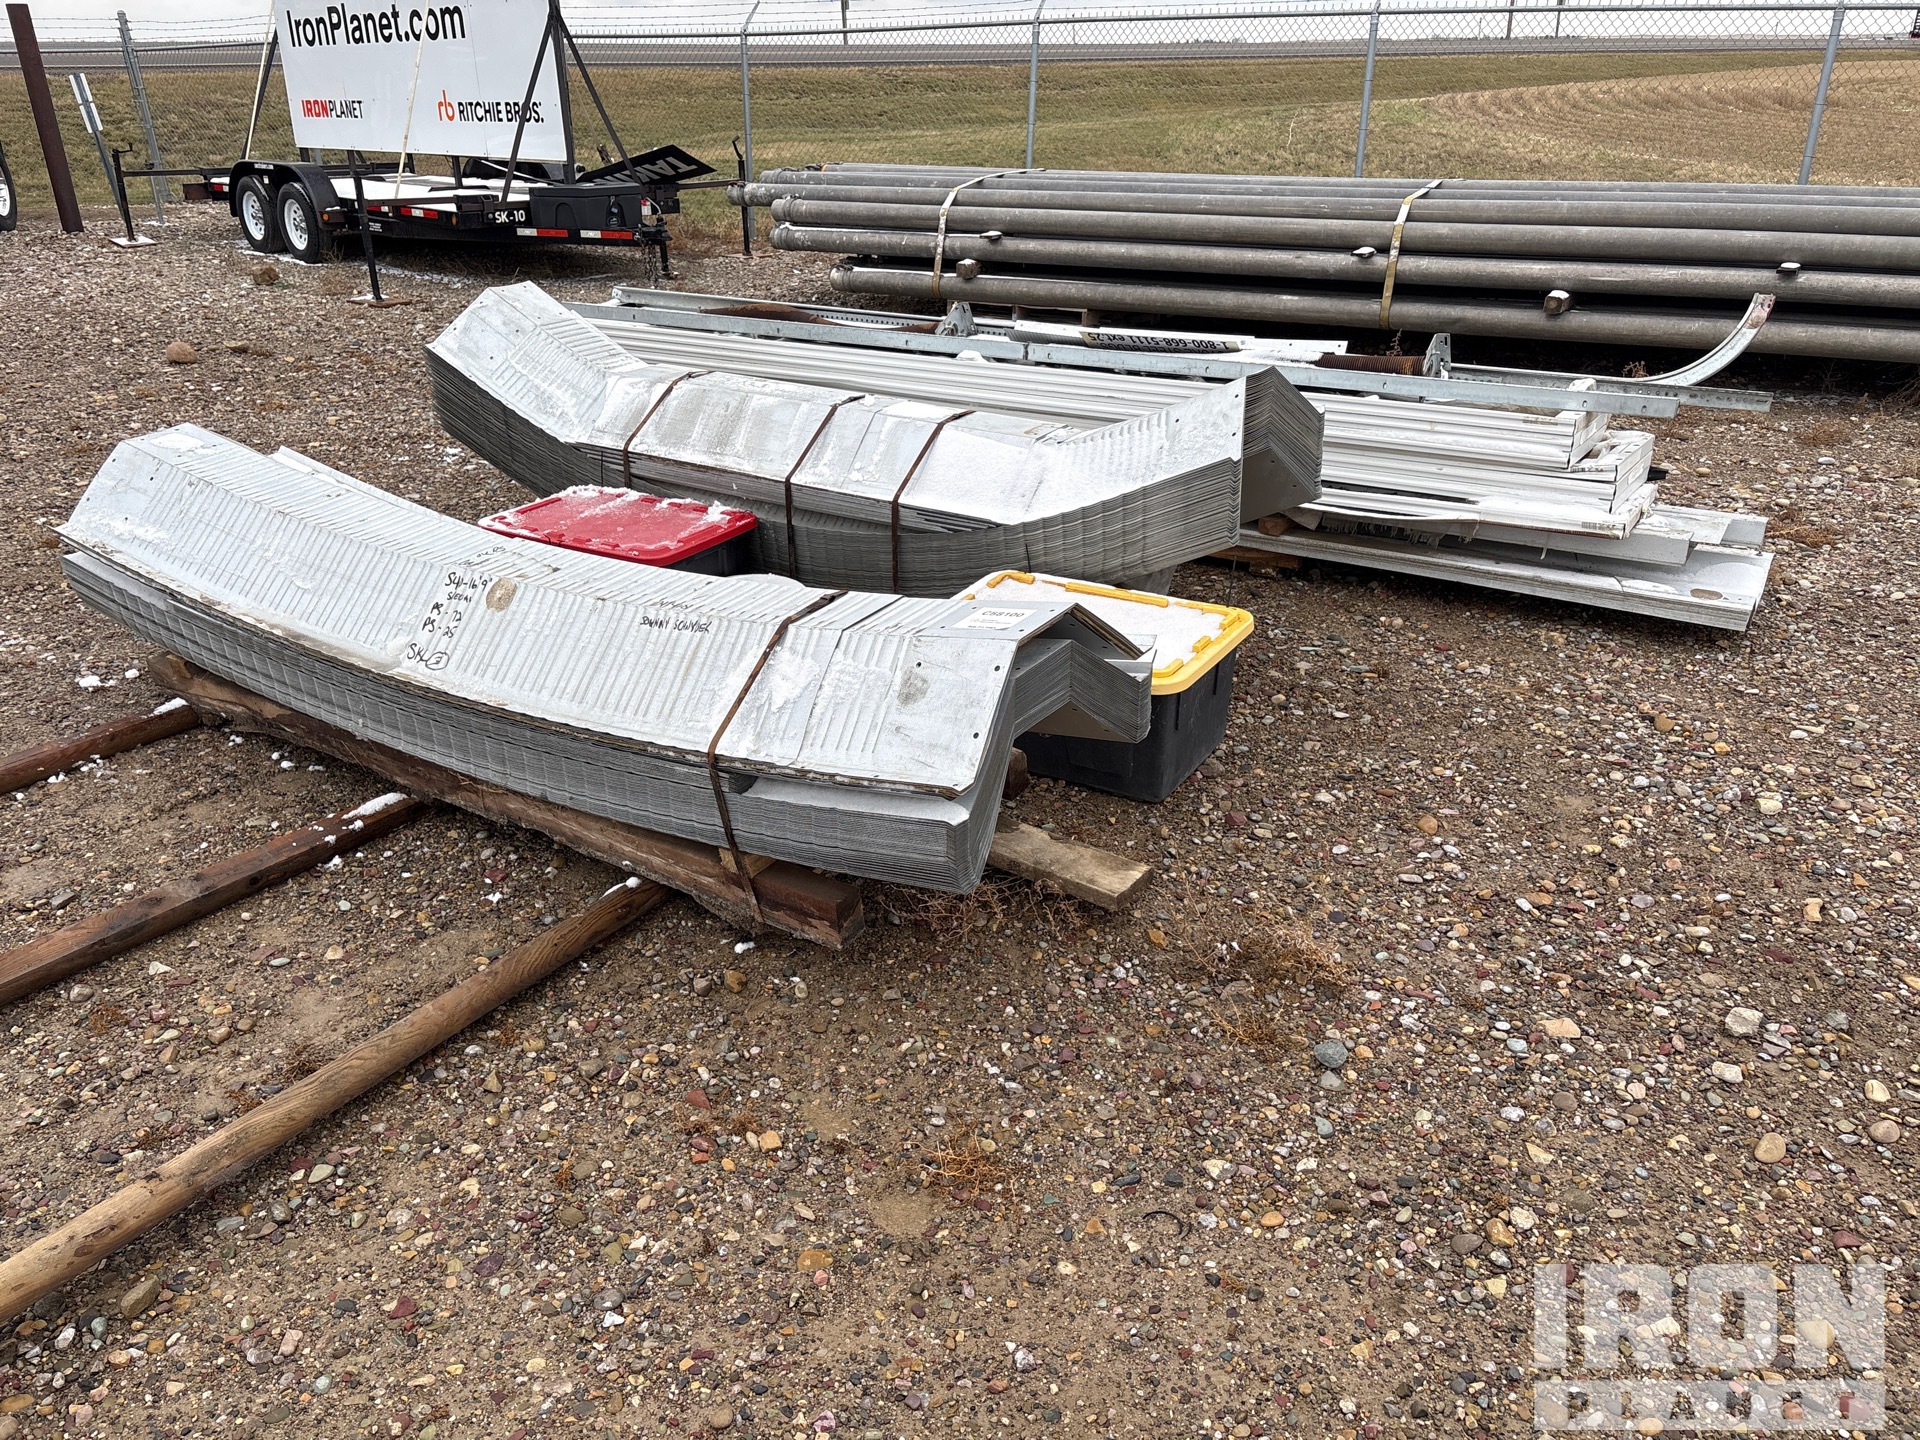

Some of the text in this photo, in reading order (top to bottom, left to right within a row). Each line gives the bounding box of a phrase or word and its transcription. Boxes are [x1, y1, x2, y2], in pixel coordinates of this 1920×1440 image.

[286, 2, 466, 47] IronPlanet.com
[301, 99, 364, 119] IRONPLANET
[458, 101, 503, 122] RITCHIE
[507, 101, 545, 123] BROS.
[495, 210, 526, 223] SK-10
